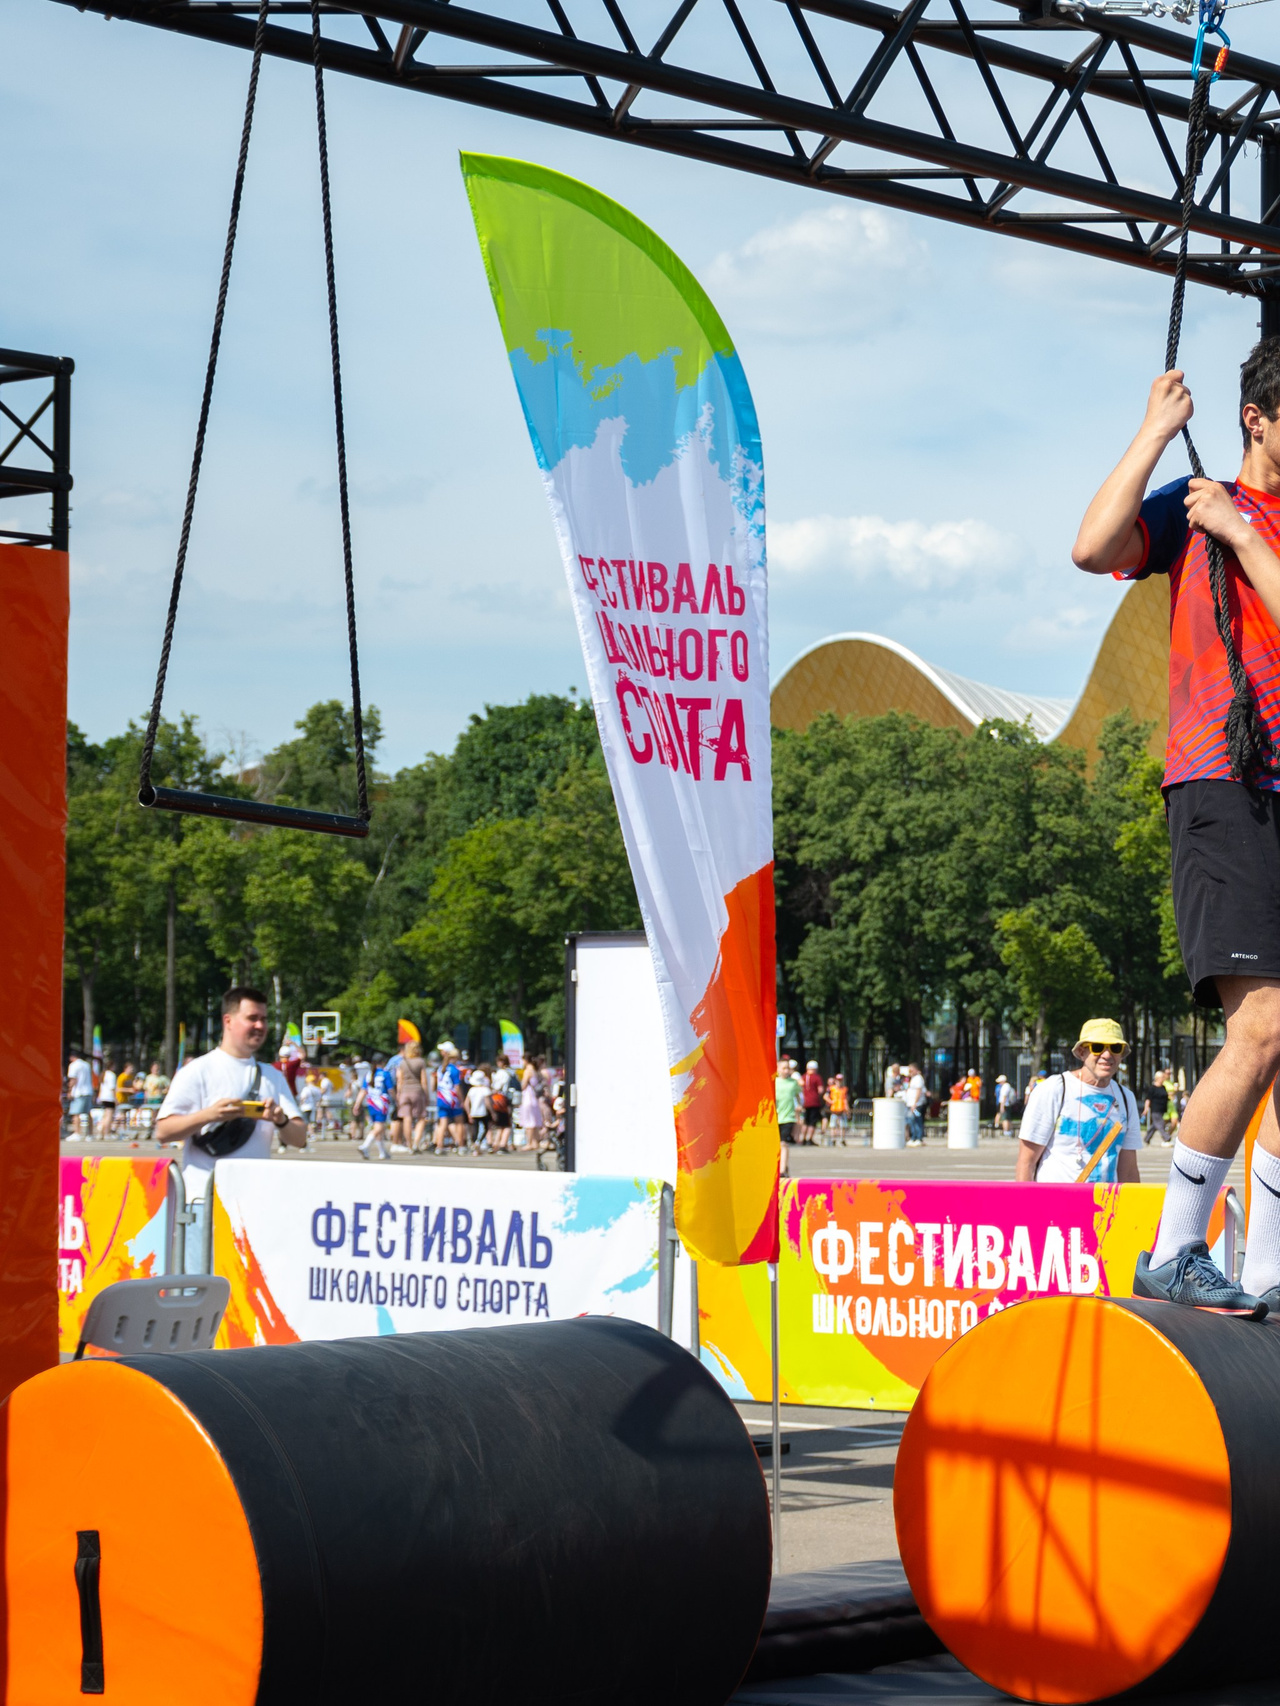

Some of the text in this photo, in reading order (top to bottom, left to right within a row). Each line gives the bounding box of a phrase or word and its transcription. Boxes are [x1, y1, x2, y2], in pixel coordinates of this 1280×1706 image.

[1231, 952, 1258, 960] ARTENGO
[311, 1200, 553, 1270] ФЕСТИВАЛЬ
[811, 1217, 1100, 1294] ФЕСТИВАЛЬ
[309, 1267, 551, 1318] ШКОЛЬНОГО СПОРТА
[812, 1293, 978, 1340] ШКОЛЬНОГО
